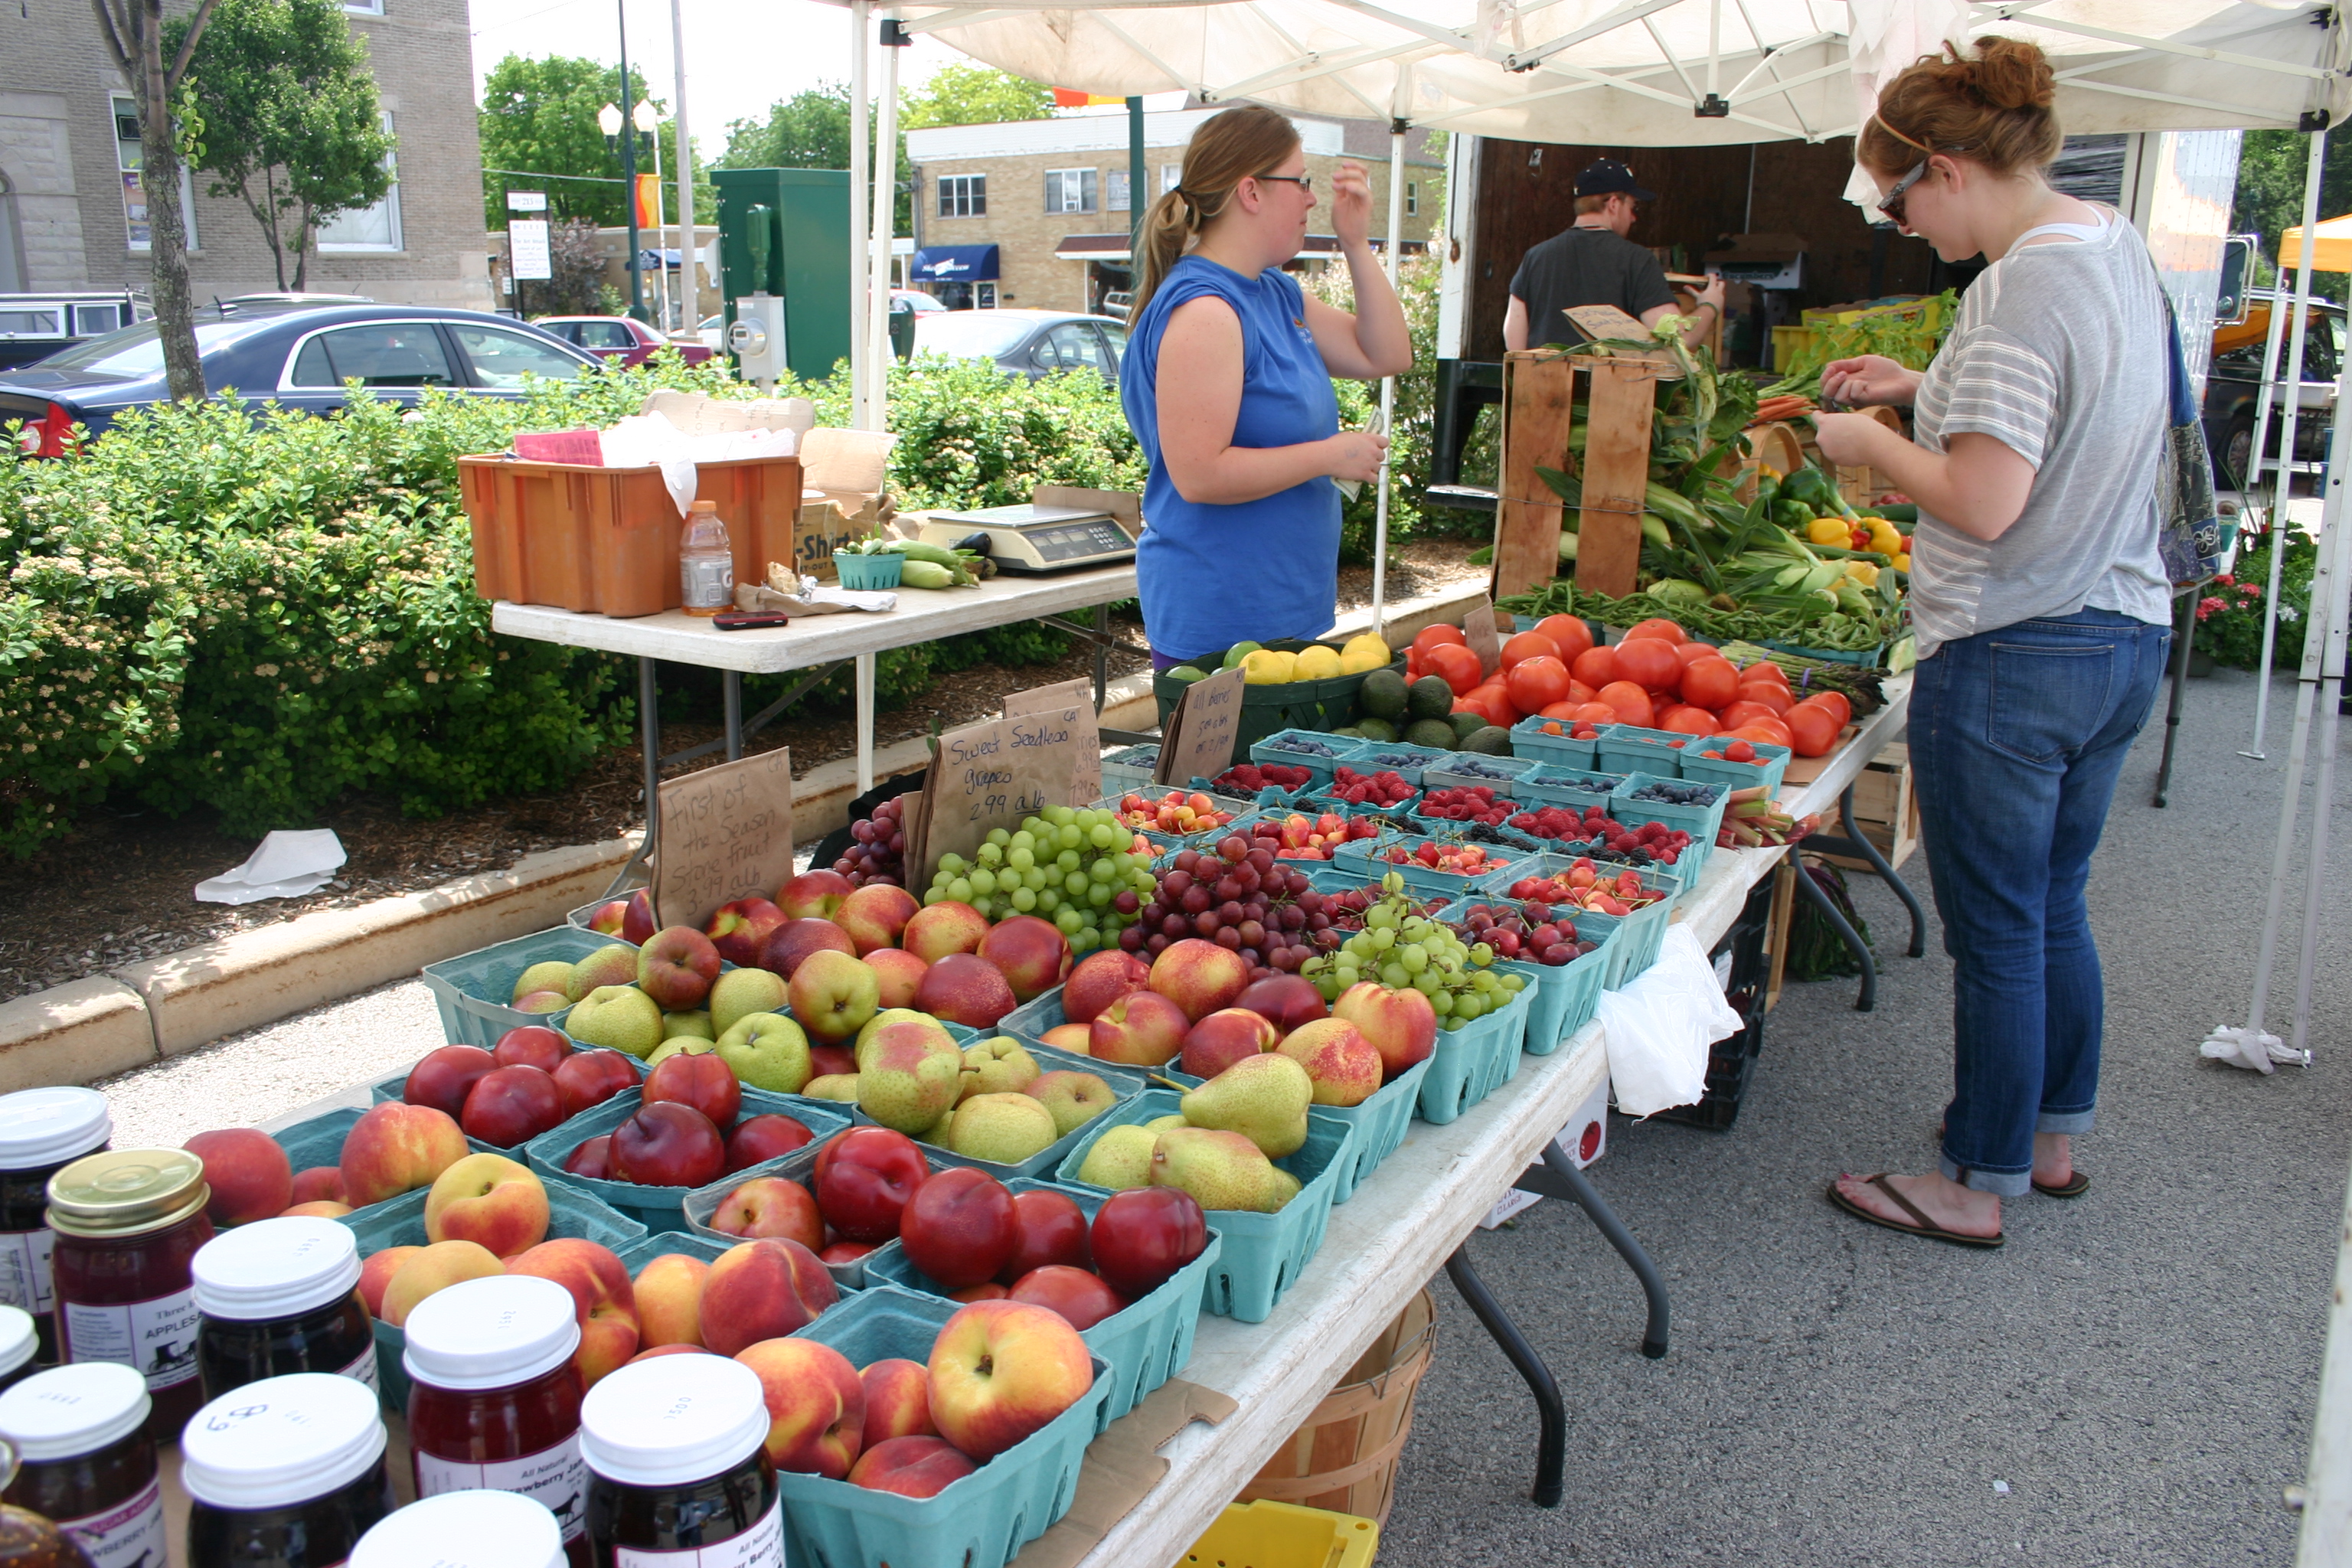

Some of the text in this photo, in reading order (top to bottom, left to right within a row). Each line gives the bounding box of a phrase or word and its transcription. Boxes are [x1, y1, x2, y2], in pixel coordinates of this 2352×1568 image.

[951, 724, 1069, 766] Sweet Seedless
[767, 754, 784, 773] CA
[964, 768, 1013, 795] grapes
[668, 773, 746, 831] First of
[969, 795, 1007, 822] 2.99
[683, 808, 776, 857] the Season
[670, 858, 721, 894] Stone
[686, 875, 724, 917] 3.99
[155, 1303, 186, 1320] Three
[521, 1453, 568, 1479] All Natural
[749, 1540, 773, 1566] Berry
